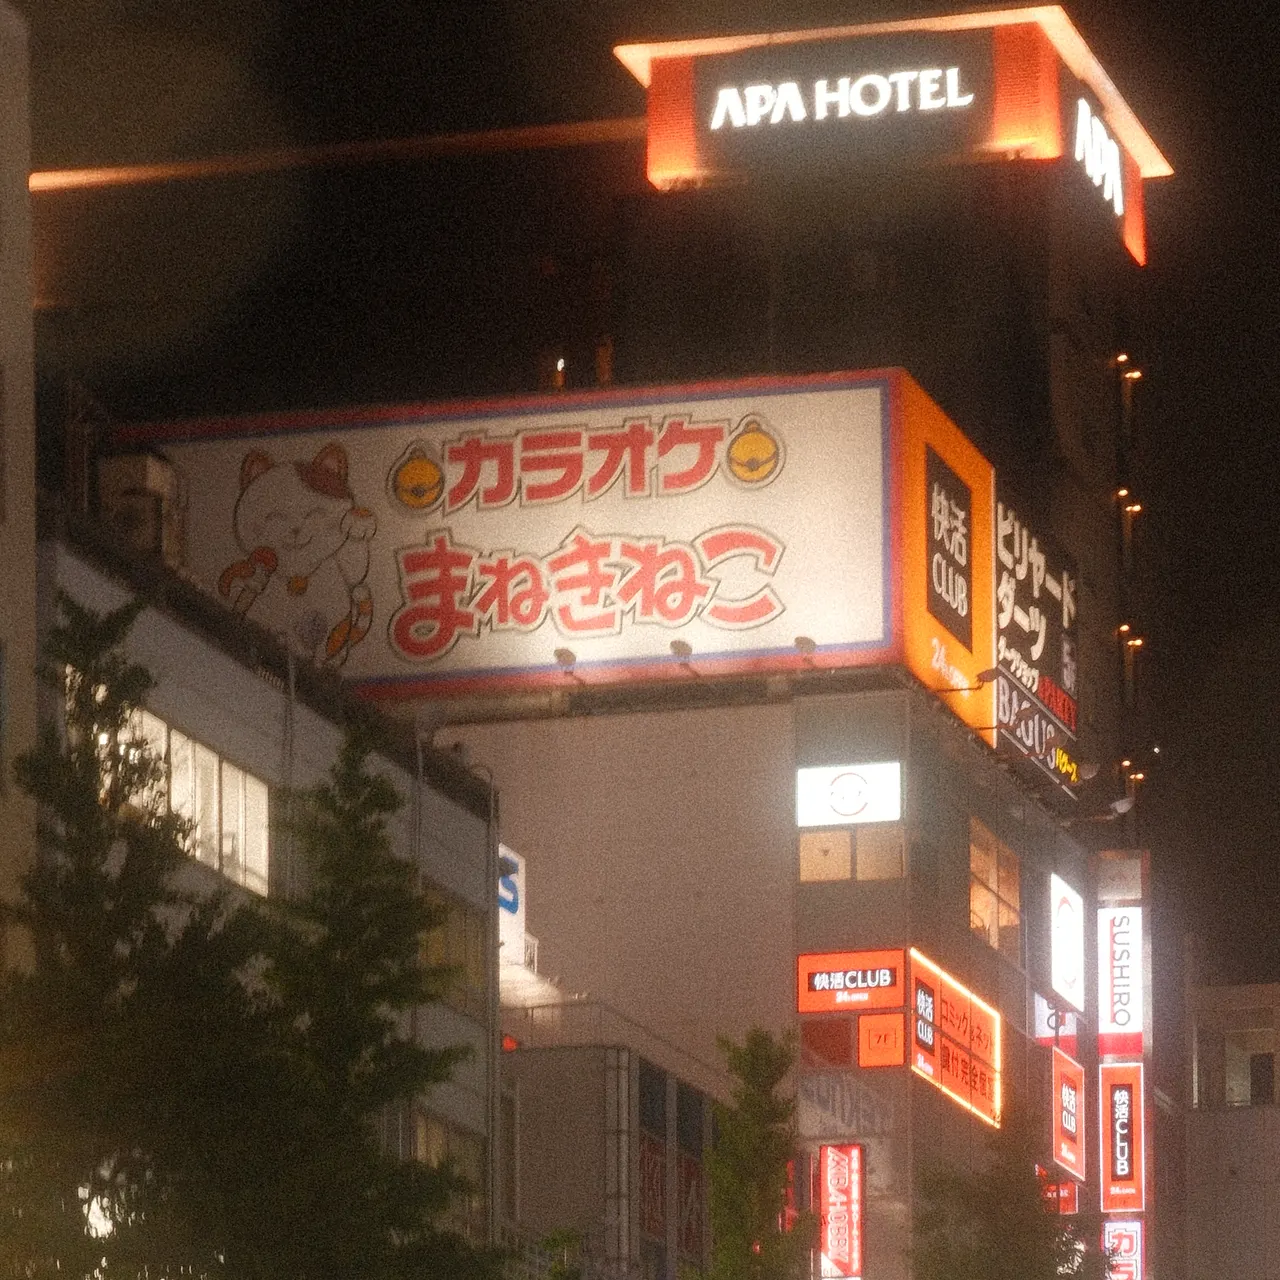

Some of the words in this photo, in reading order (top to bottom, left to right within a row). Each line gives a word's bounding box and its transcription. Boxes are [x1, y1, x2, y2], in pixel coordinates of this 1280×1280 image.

[710, 82, 807, 130] APA
[814, 67, 974, 120] HOTEL
[446, 419, 724, 512] カラオケ
[932, 482, 967, 567] 快活
[998, 502, 1076, 628] ビリヤード
[396, 530, 785, 658] まねきねこ
[932, 552, 967, 617] CLUB
[998, 570, 1046, 661] ダーツ
[814, 969, 891, 990] 快活CLUB
[1113, 915, 1131, 1026] SUSHIRO
[917, 1021, 933, 1046] CLUB
